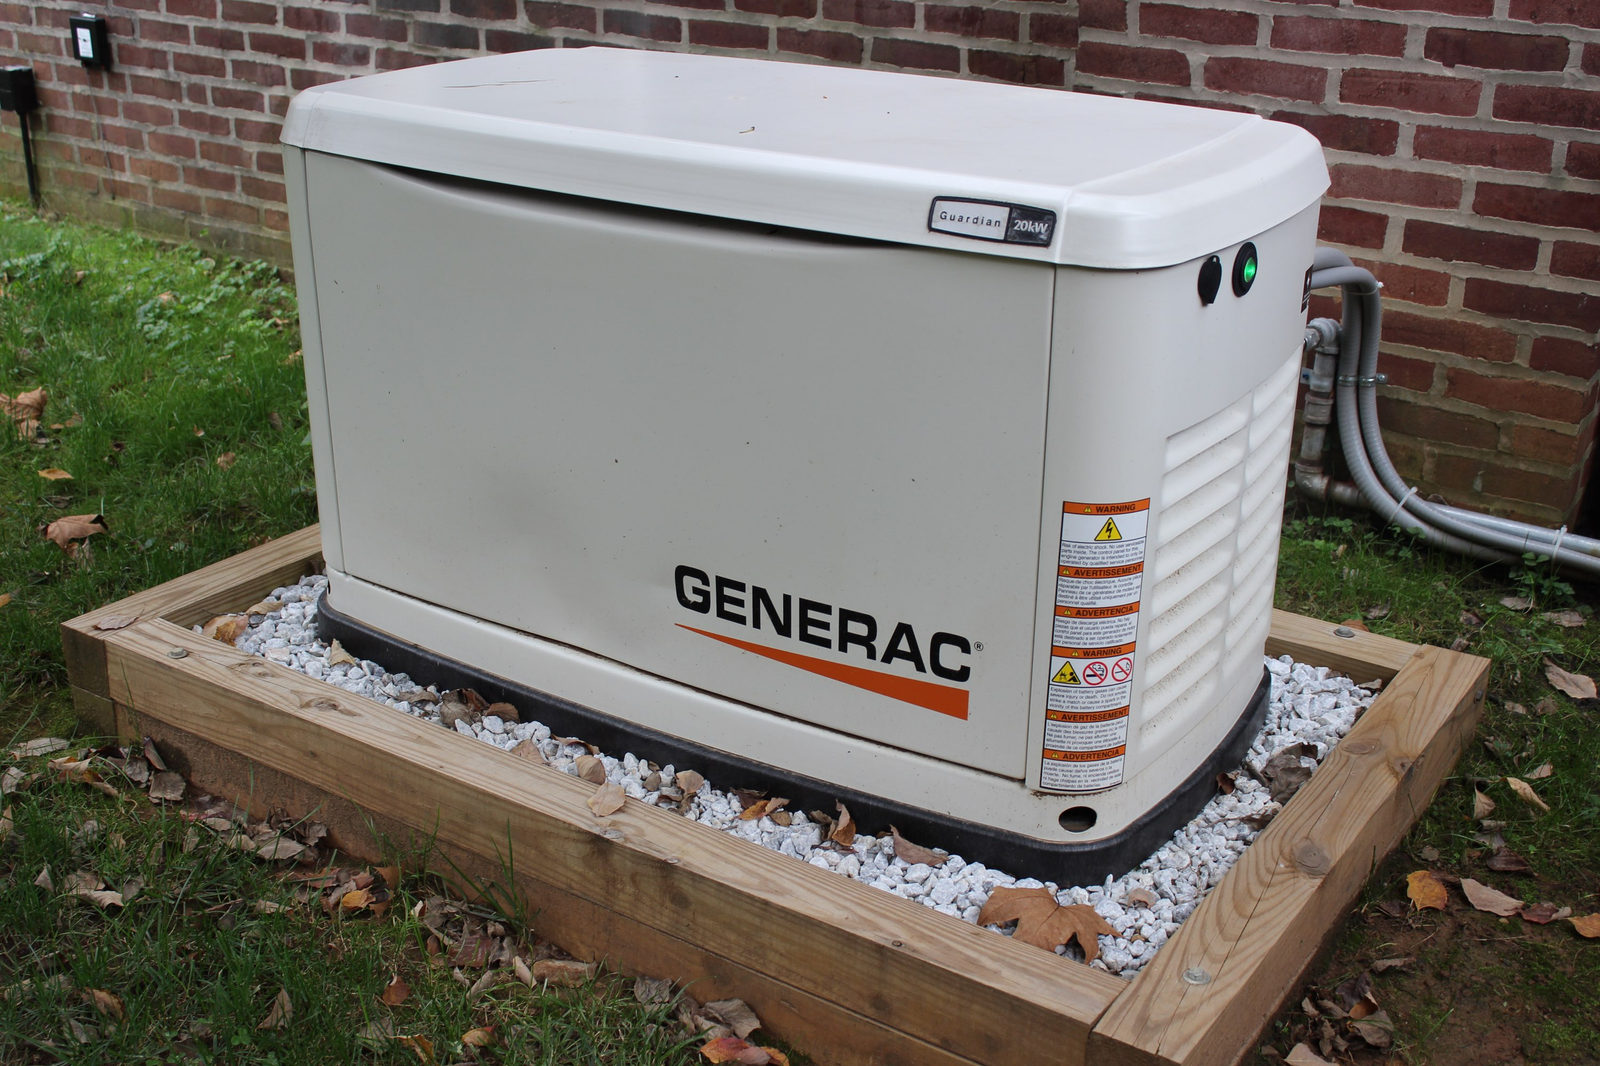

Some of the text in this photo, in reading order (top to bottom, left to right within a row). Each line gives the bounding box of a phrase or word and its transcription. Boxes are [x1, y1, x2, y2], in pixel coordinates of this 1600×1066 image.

[939, 210, 1049, 233] Guardian 20kW
[1096, 504, 1135, 512] WARNING
[1074, 565, 1141, 576] AVERTISSEMENT
[1076, 606, 1133, 616] ADVERTENCIA
[674, 564, 971, 682] GENERAC
[1062, 710, 1127, 720] AVERTISSEMENT
[1063, 749, 1119, 760] ADVERTENCIA
